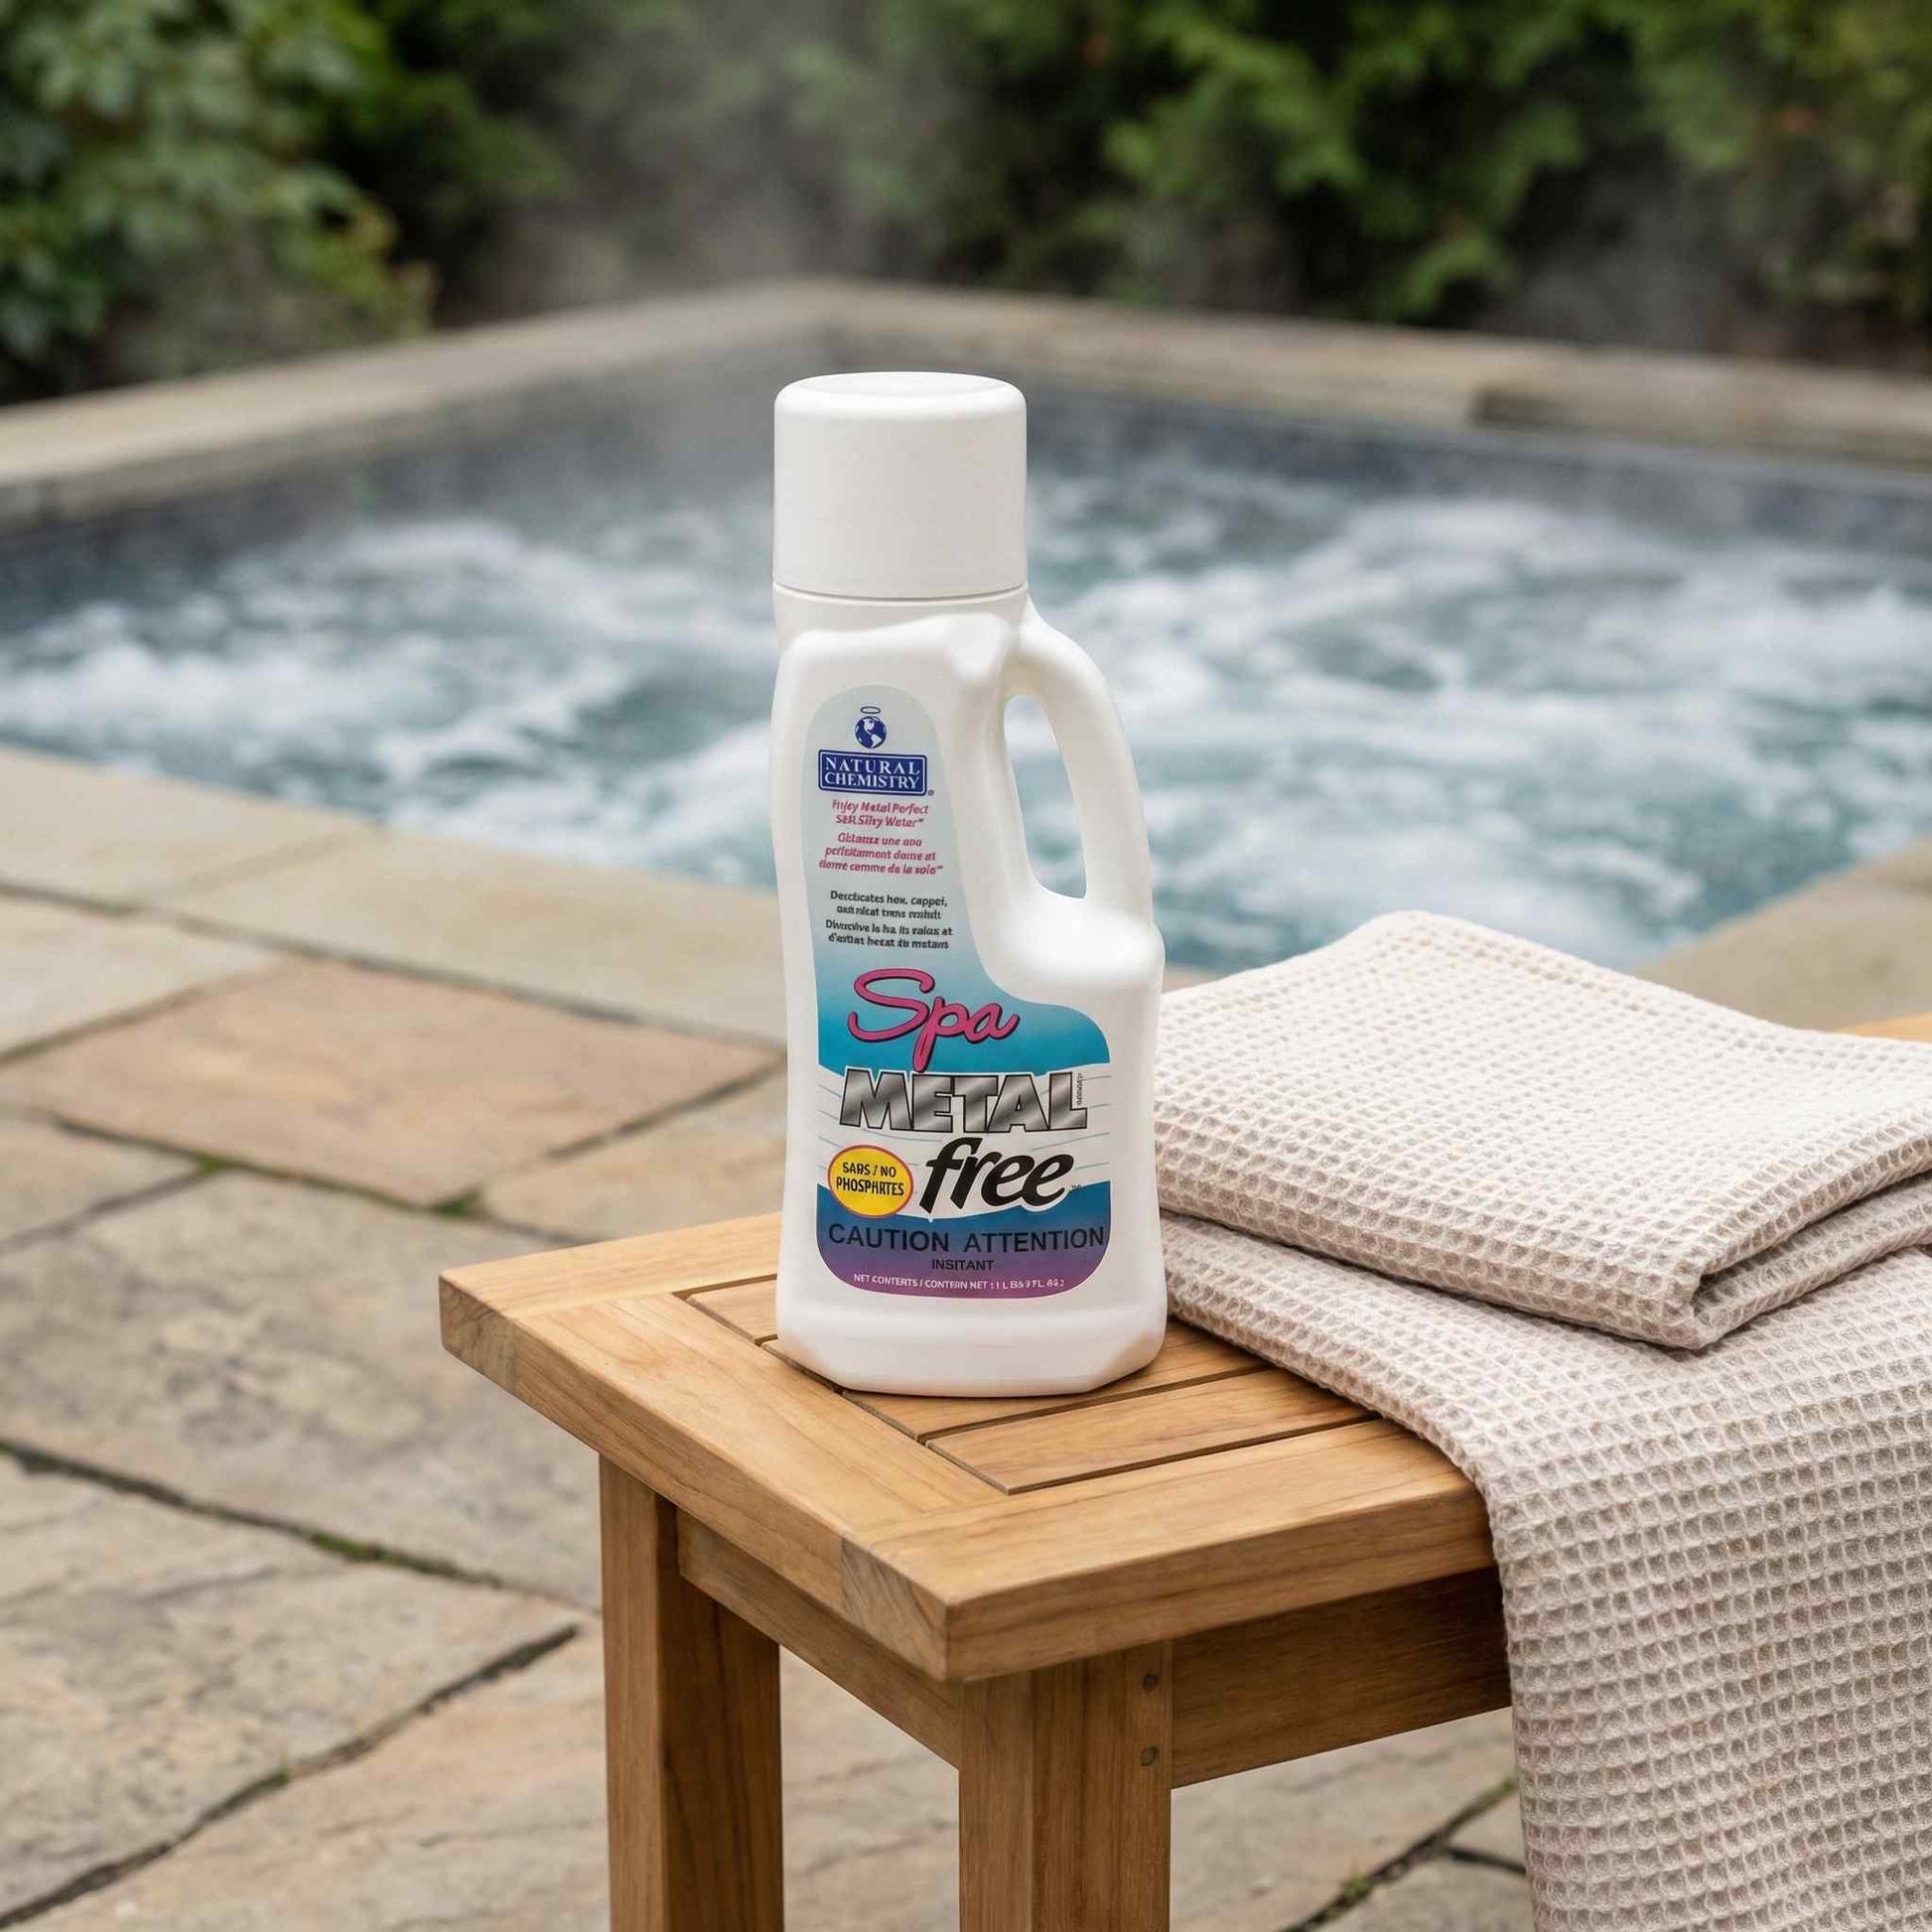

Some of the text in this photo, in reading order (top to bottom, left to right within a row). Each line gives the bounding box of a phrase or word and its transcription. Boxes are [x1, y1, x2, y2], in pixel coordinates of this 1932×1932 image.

[825, 757, 920, 775] NATURAL
[824, 771, 920, 789] CHEMISTRY
[847, 968, 1021, 1073] Spa
[839, 1067, 1088, 1134] METAL
[880, 1165, 897, 1178] NO
[918, 1137, 1075, 1215] free
[828, 1222, 1104, 1254] CAUTION ATTENTION
[853, 1274, 870, 1284] NET
[969, 1280, 989, 1290] NET
